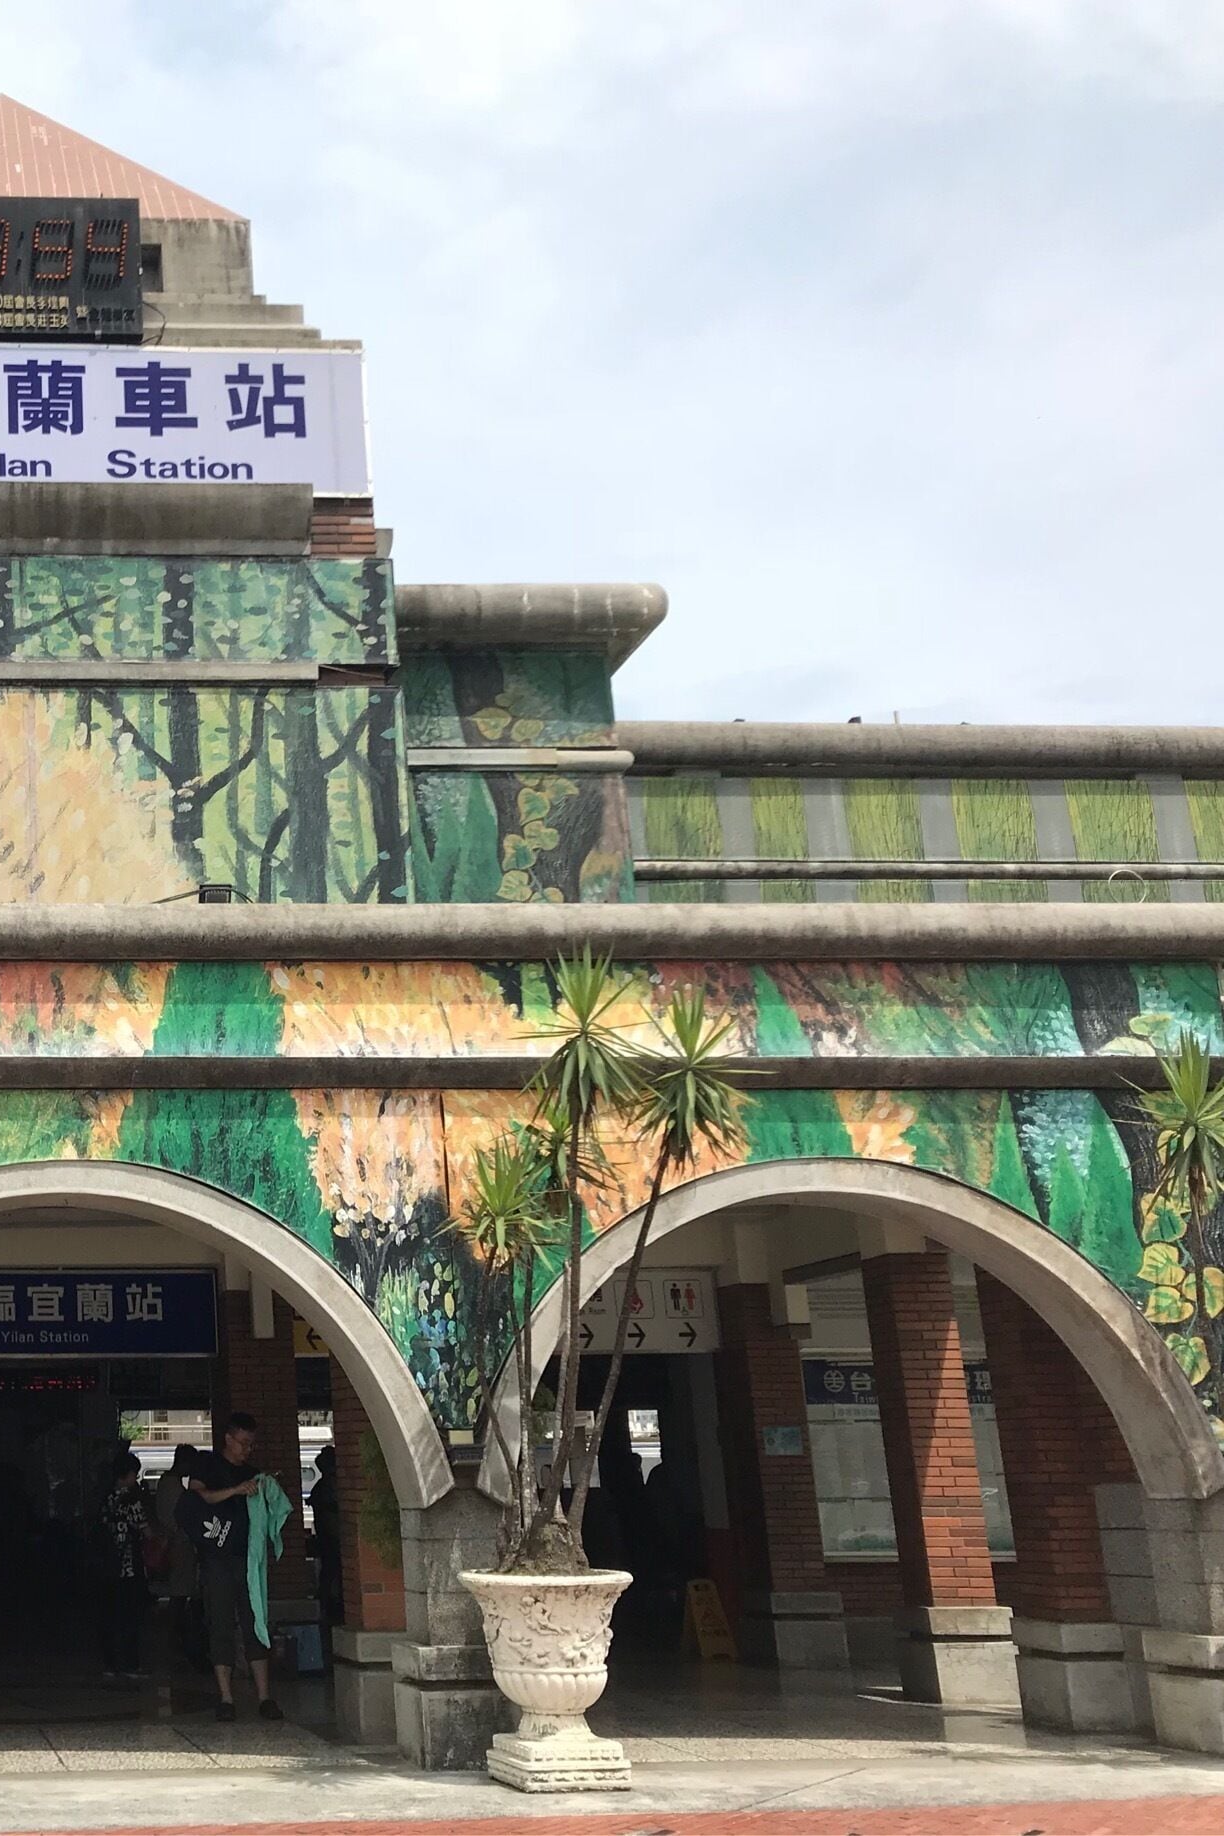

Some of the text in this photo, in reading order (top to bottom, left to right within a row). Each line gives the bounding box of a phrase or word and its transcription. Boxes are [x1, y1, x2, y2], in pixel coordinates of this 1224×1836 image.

[106, 449, 254, 480] Station
[1, 1331, 34, 1343] Yilan
[39, 1330, 89, 1343] Station
[217, 1519, 232, 1548] adidas
